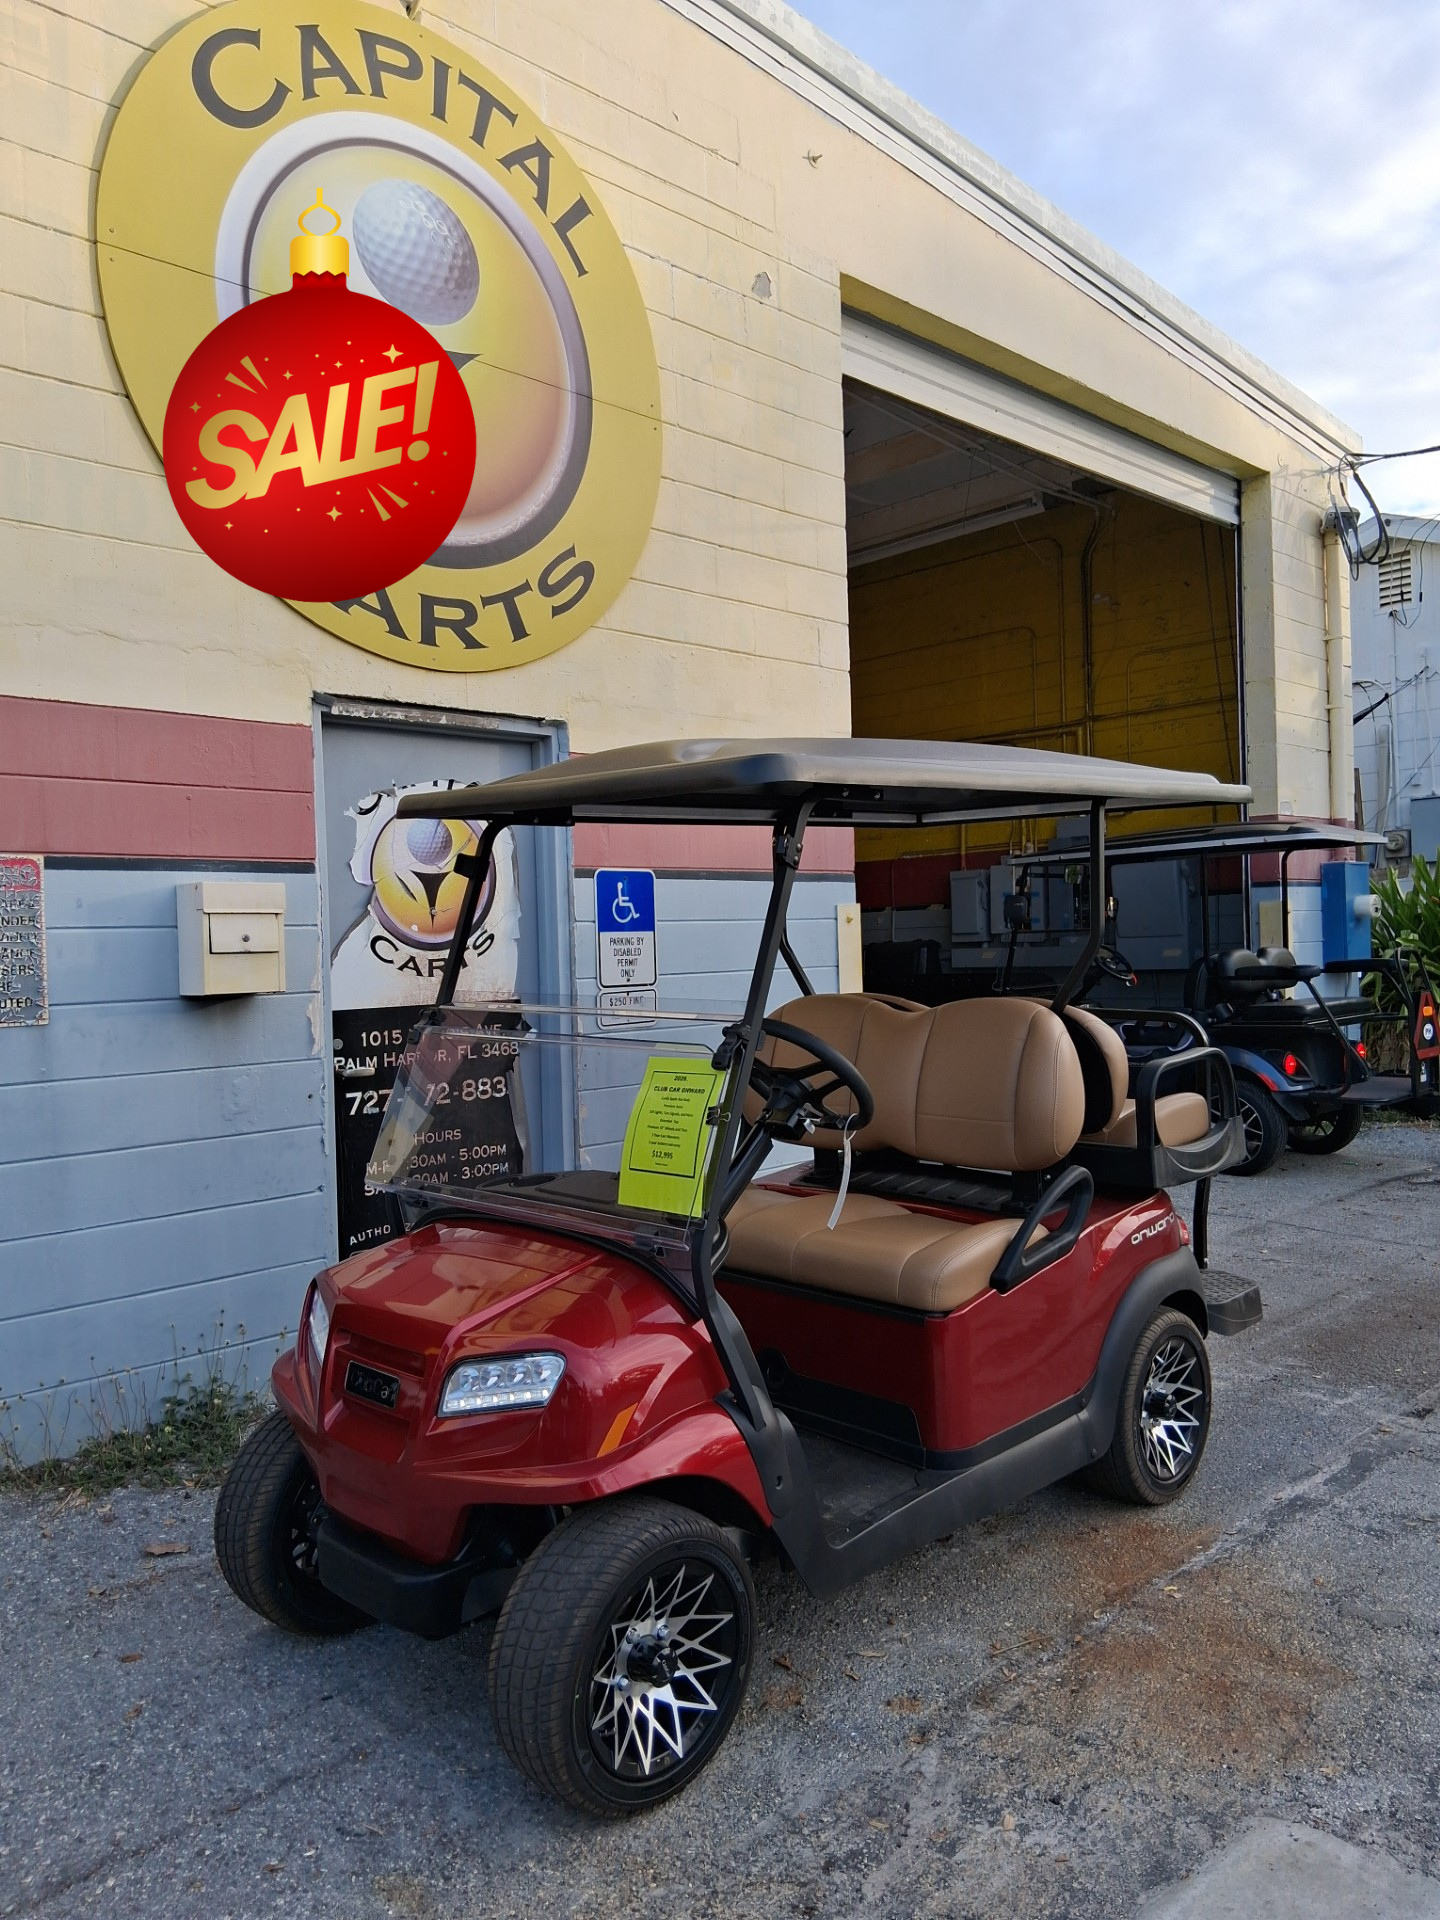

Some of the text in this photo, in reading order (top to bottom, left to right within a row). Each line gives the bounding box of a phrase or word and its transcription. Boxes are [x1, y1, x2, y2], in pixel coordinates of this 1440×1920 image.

[191, 24, 595, 278] CAPITAL
[329, 544, 595, 650] ARTS
[609, 937, 644, 946] PARKING BY
[613, 947, 641, 957] DISABLED
[617, 958, 638, 967] PERMIT
[620, 968, 635, 978] ONLY
[609, 997, 626, 1007] $250
[361, 1029, 403, 1047] 1015
[334, 1055, 378, 1070] PALM
[383, 1049, 451, 1068] HARR,
[457, 1044, 477, 1060] FL
[681, 1087, 705, 1095] ONWARD
[413, 1129, 462, 1146] HOURS
[459, 1144, 507, 1161] 5:00PM
[364, 1184, 386, 1196] SA
[461, 1162, 509, 1180] 3:00PM
